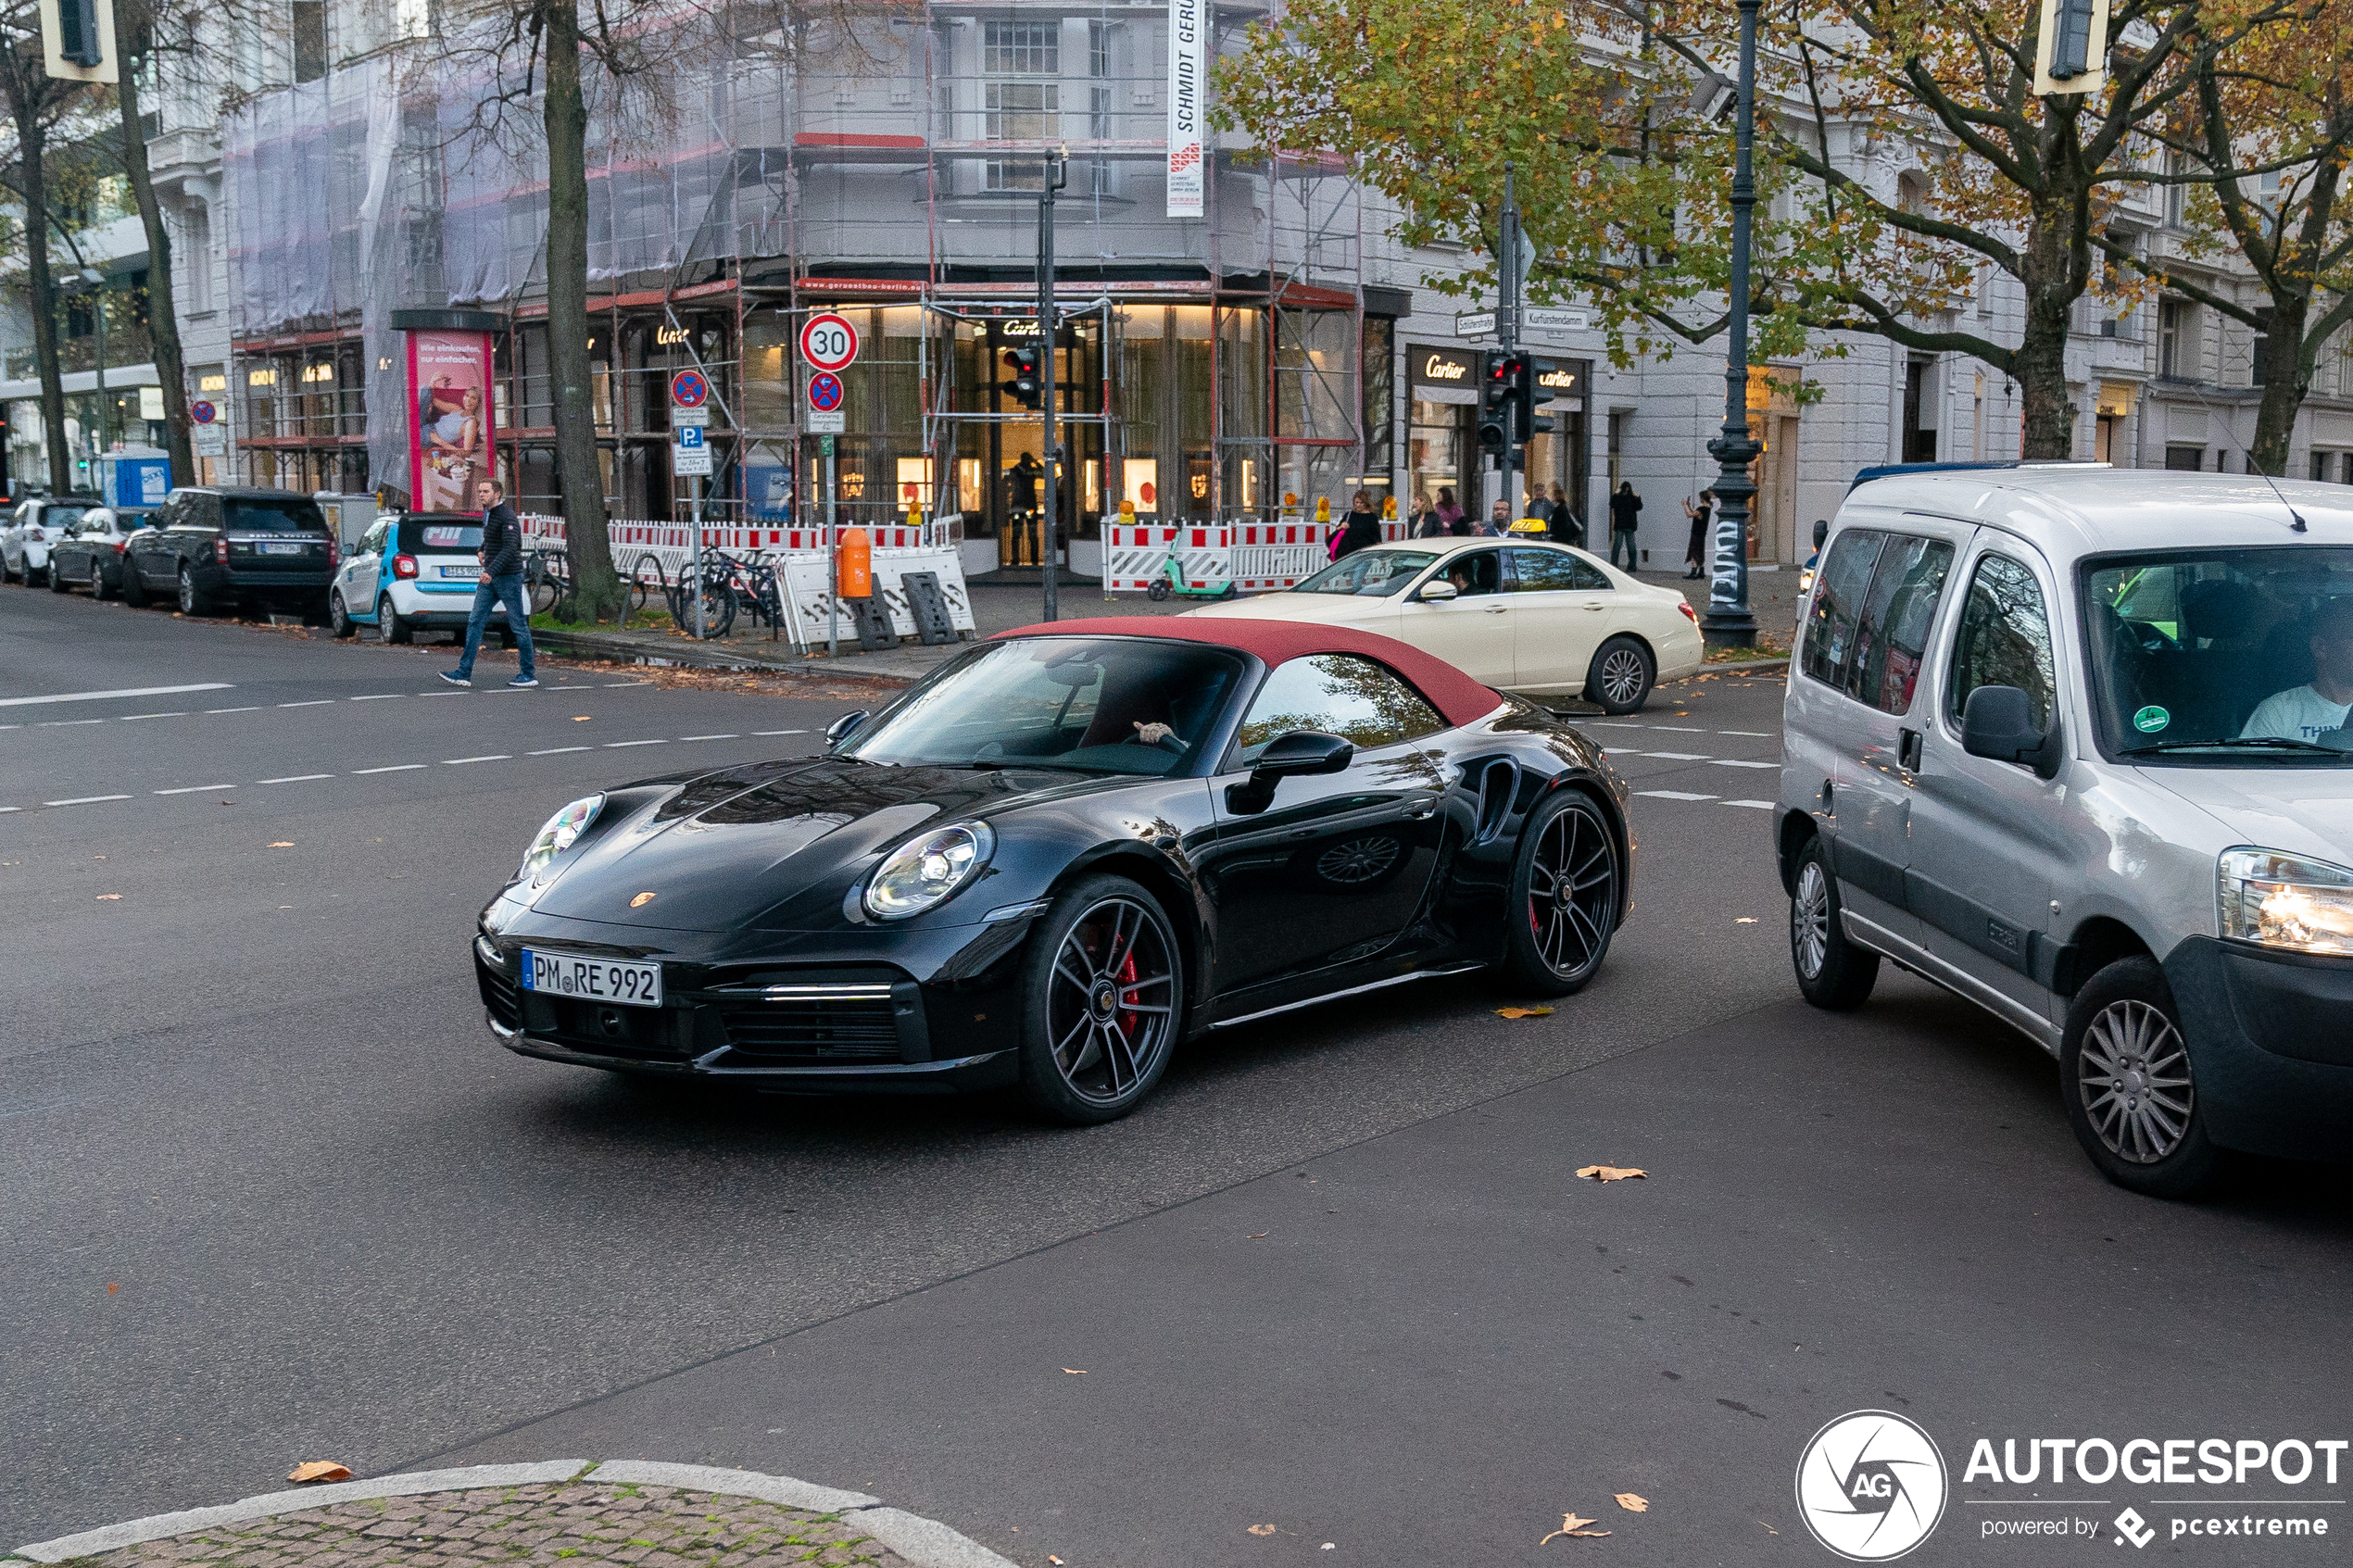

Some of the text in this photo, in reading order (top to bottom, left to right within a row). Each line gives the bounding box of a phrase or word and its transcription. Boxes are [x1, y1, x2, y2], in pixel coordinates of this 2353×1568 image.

[1177, 50, 1194, 132] SCHMIDT
[1459, 316, 1493, 331] Schlüterstraße
[1529, 313, 1582, 325] Kurfürstendamm
[813, 330, 846, 356] 30
[1425, 354, 1466, 380] Cartier
[683, 428, 696, 445] P
[2145, 708, 2157, 719] 4
[535, 957, 655, 1000] PM RE 992
